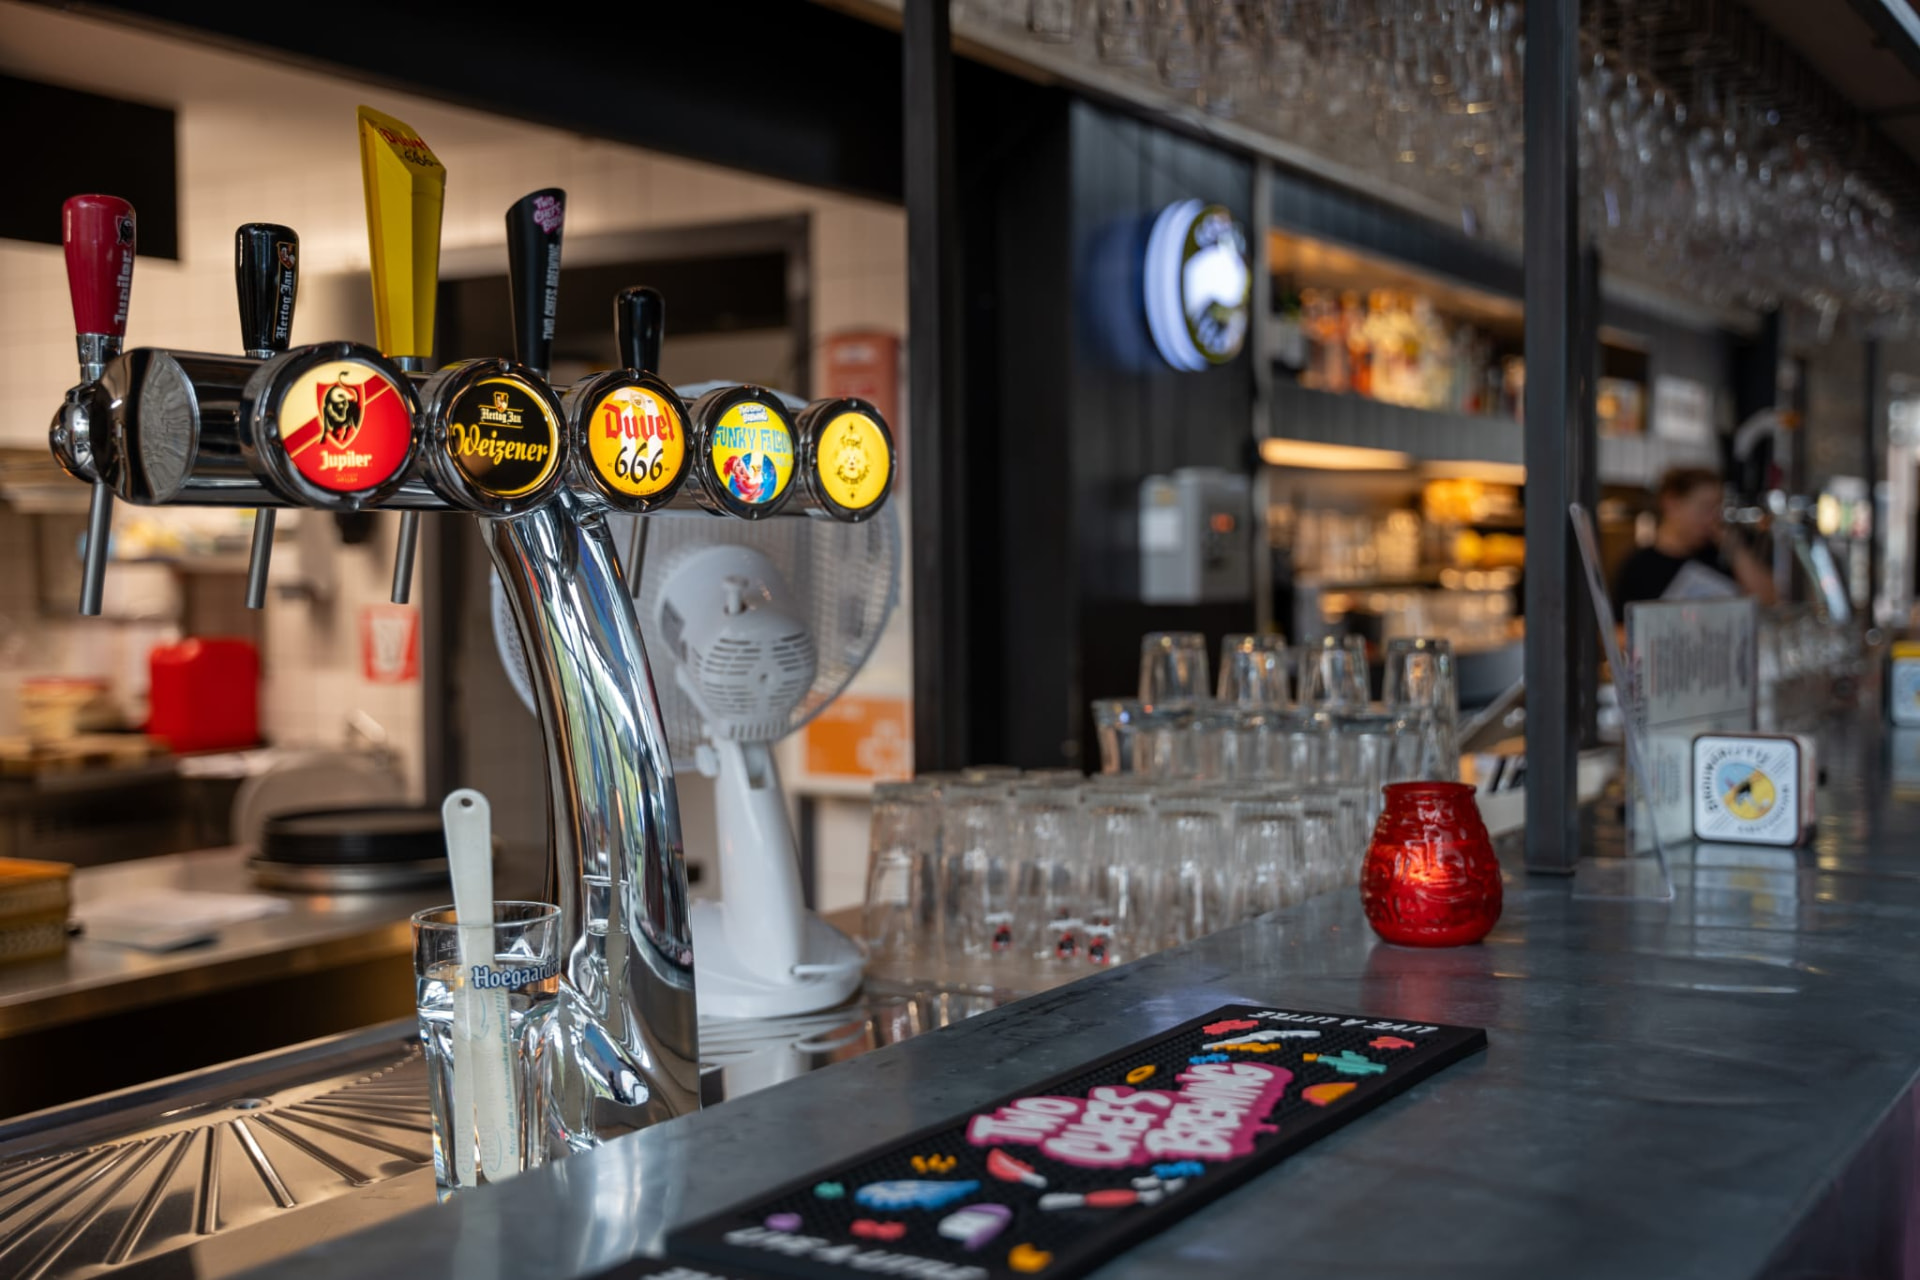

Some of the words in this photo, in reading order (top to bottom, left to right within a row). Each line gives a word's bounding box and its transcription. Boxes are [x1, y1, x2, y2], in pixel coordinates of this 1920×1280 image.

[280, 271, 292, 295] Jan
[276, 296, 292, 340] Hertog
[544, 288, 557, 317] CHEFS
[543, 318, 555, 340] TWO
[480, 408, 506, 424] Hertog
[506, 411, 522, 424] Jan
[603, 403, 675, 442] Duvel
[449, 423, 548, 465] Weizener
[714, 426, 756, 450] FUNKY
[320, 450, 372, 471] Jupiler
[972, 1097, 1078, 1139] TWO
[1045, 1087, 1171, 1160] CHEFS
[1144, 1063, 1274, 1155] BREWING
